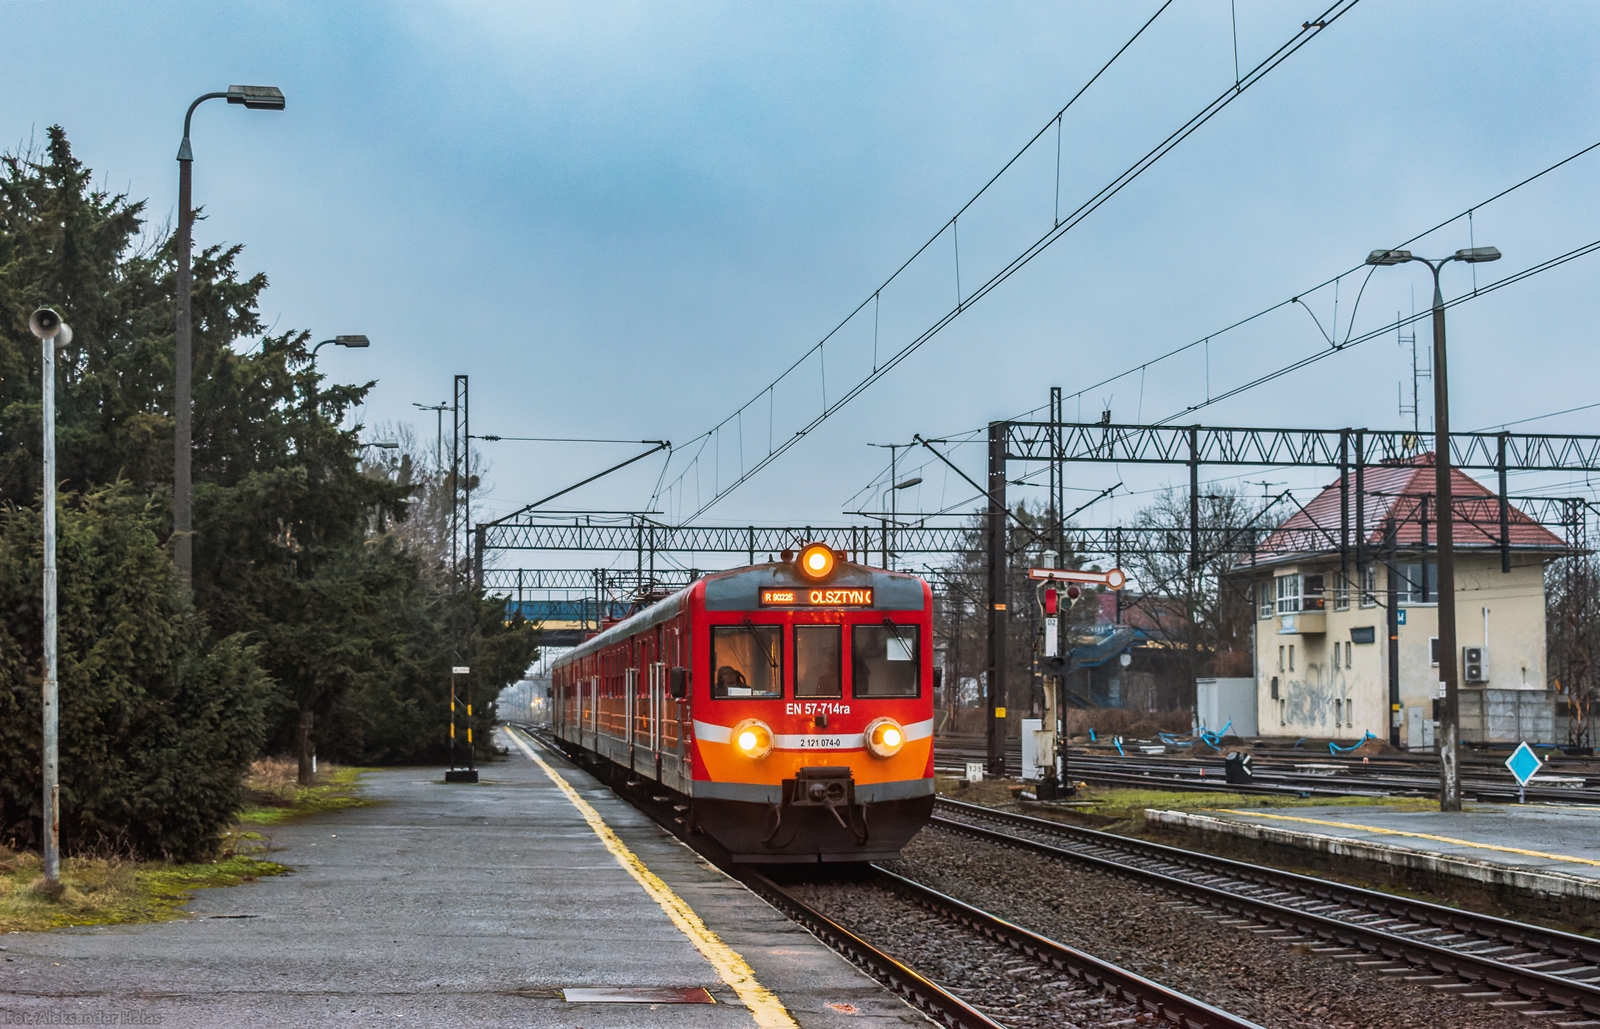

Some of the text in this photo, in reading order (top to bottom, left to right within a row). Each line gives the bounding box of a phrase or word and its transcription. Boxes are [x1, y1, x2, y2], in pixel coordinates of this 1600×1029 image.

[765, 593, 772, 602] R
[810, 591, 864, 603] OLSZTYN
[786, 702, 850, 715] EN 57-714ra
[800, 739, 841, 747] 2 121 074-0
